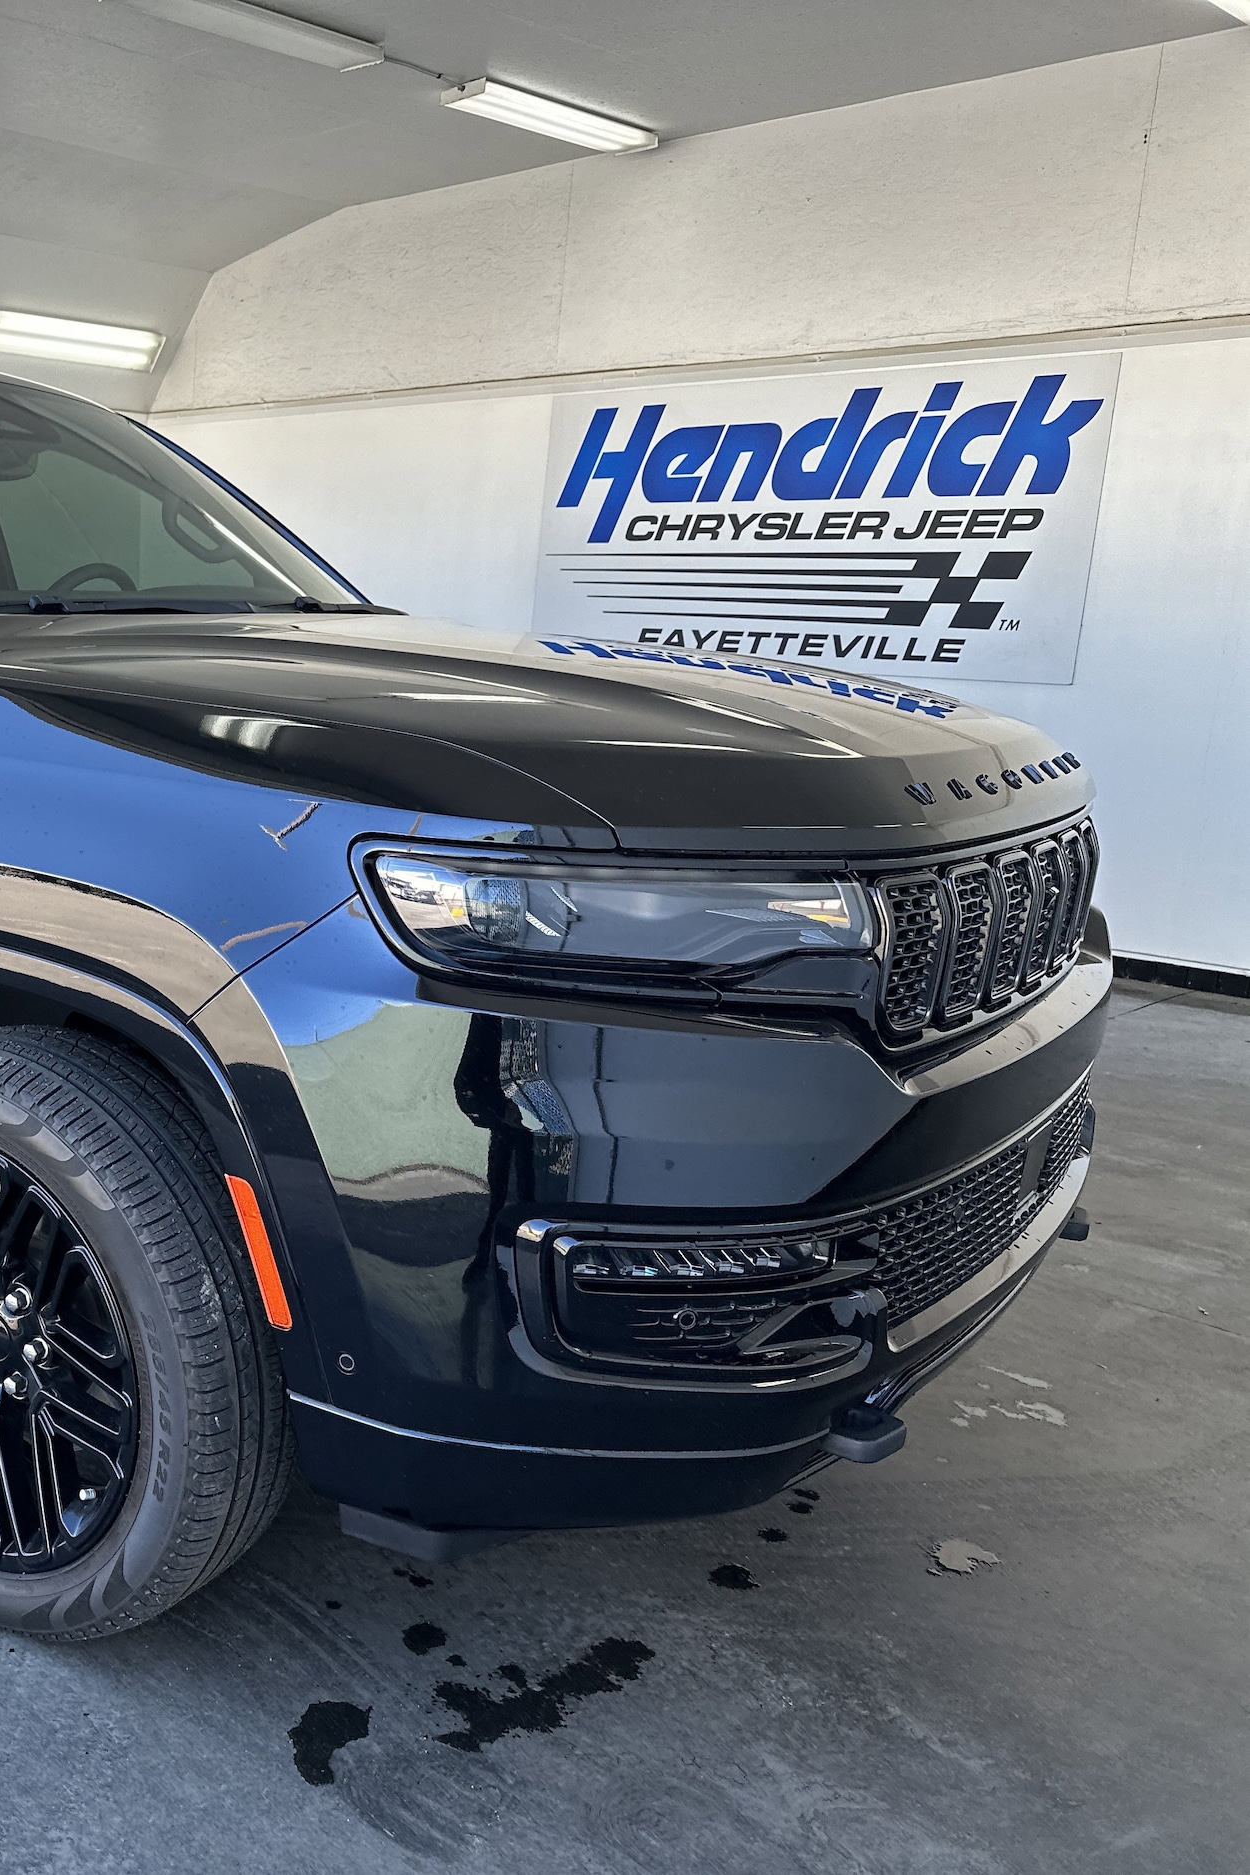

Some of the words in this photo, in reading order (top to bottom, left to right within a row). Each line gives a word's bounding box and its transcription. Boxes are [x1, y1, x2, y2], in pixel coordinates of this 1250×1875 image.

[556, 374, 1104, 543] Hendrick
[625, 511, 891, 542] CHRYSLER
[894, 508, 1045, 540] JEEP
[999, 619, 1020, 631] TM
[638, 628, 966, 663] FAYETTEVILLE
